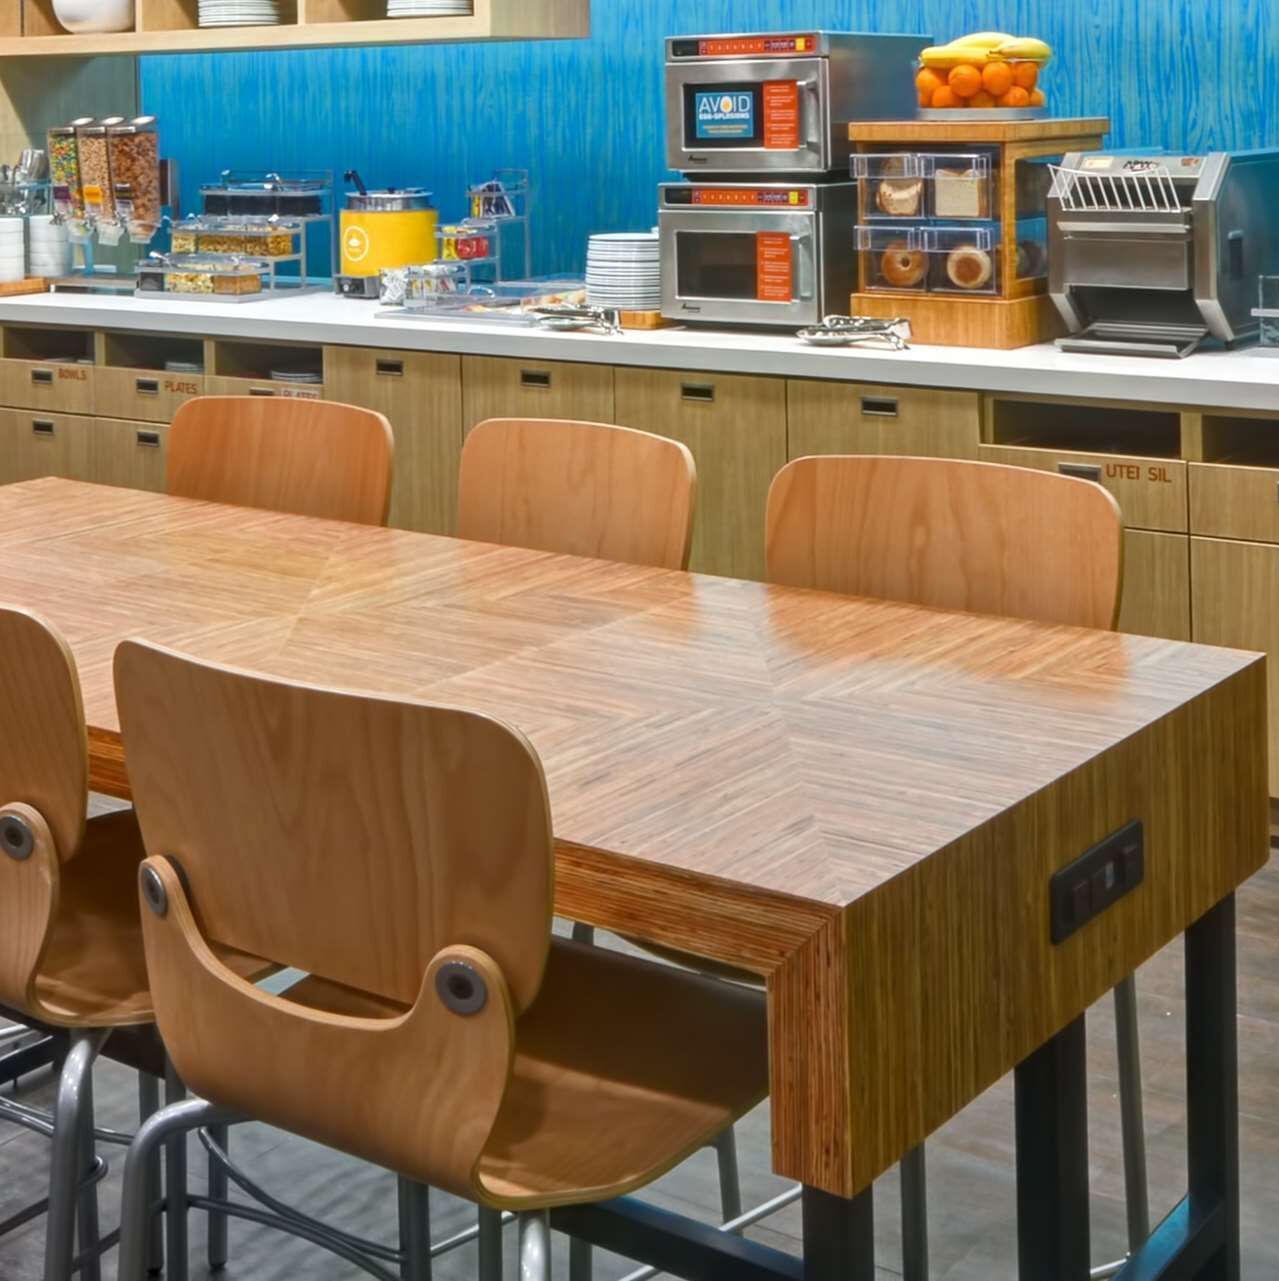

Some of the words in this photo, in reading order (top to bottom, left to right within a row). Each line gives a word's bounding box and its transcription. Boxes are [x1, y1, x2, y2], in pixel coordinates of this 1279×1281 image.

[699, 95, 751, 112] AVOID
[58, 368, 87, 380] BOWLS
[165, 380, 197, 394] PLATES
